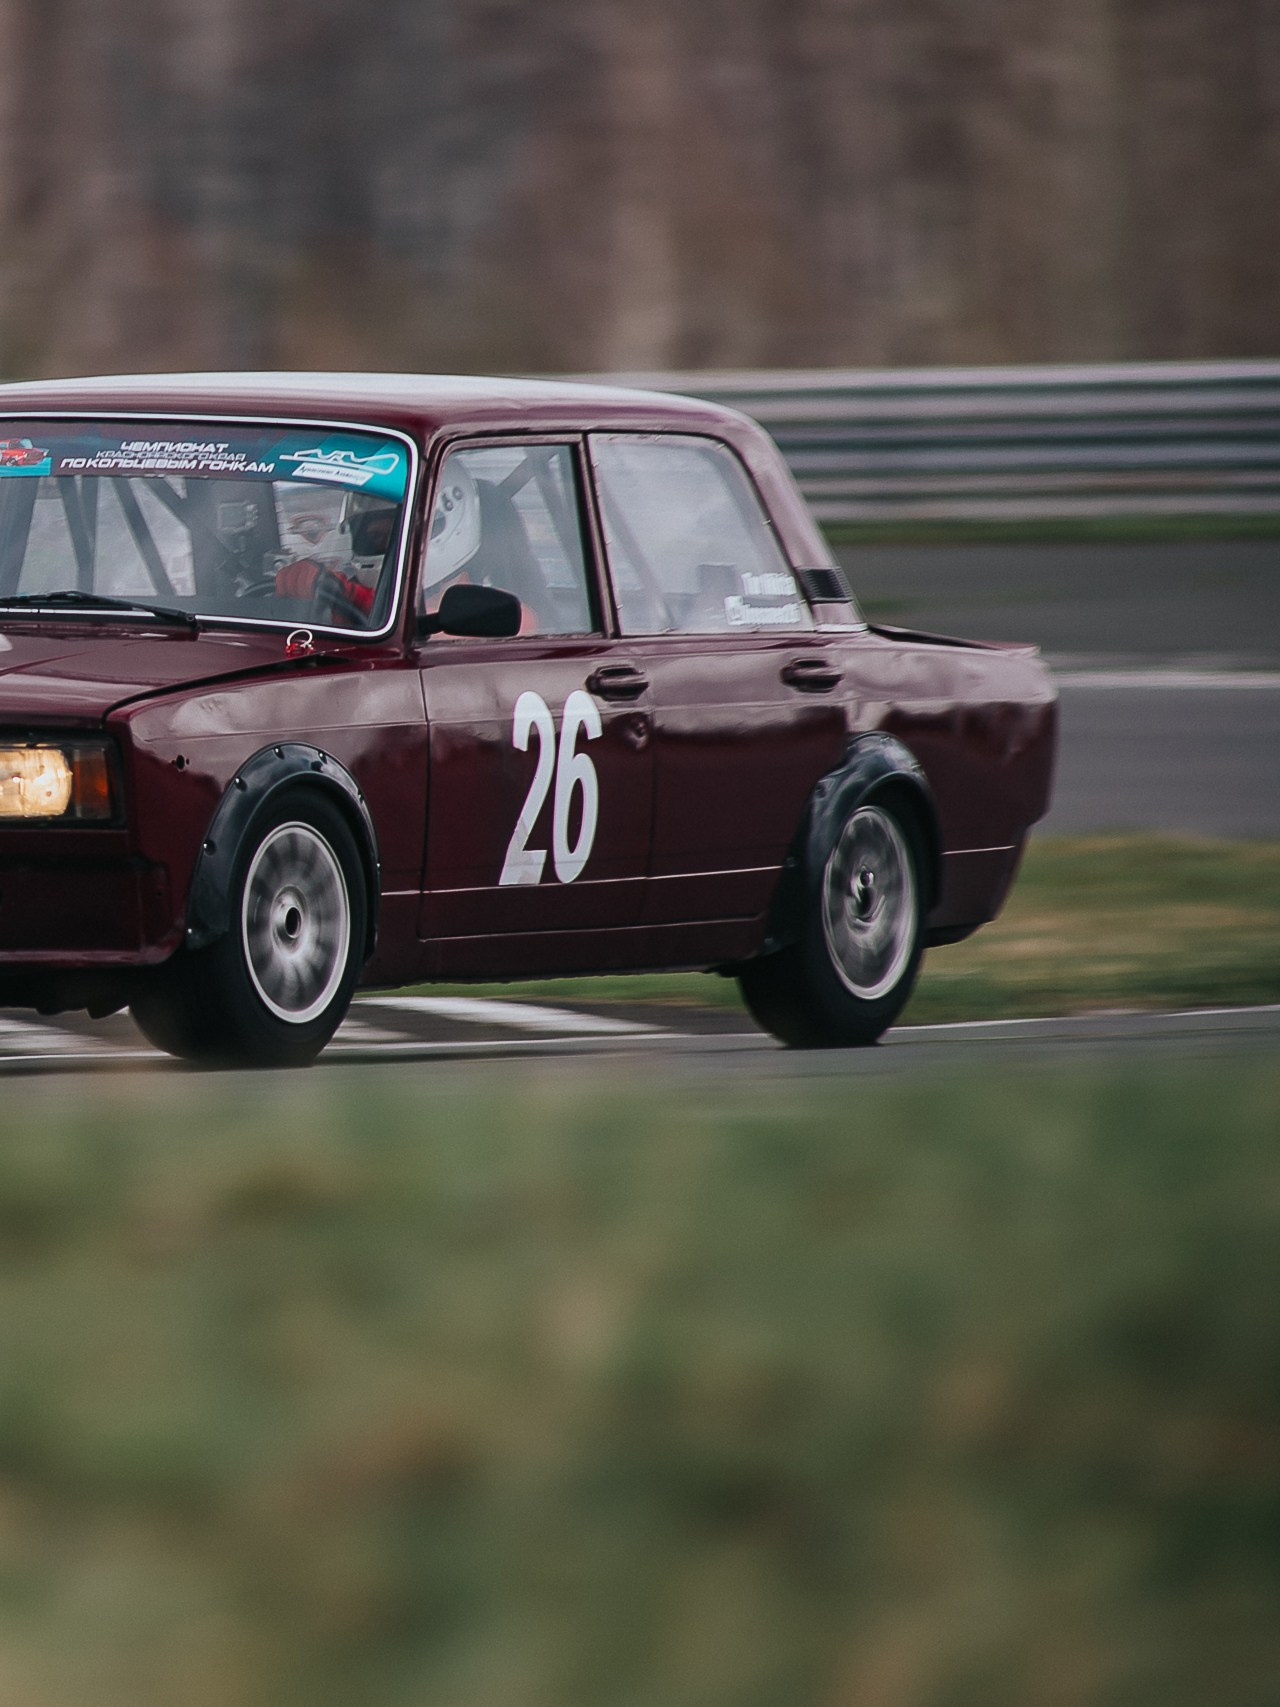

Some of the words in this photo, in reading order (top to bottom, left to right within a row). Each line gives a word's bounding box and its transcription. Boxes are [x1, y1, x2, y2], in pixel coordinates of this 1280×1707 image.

[120, 441, 229, 453] ЧЕМПИОНАТ
[60, 458, 85, 468] ПО
[85, 458, 196, 470] КОЛЬЦЕВЫМ
[197, 459, 275, 473] ГОНКАМ
[499, 690, 602, 885] 26
